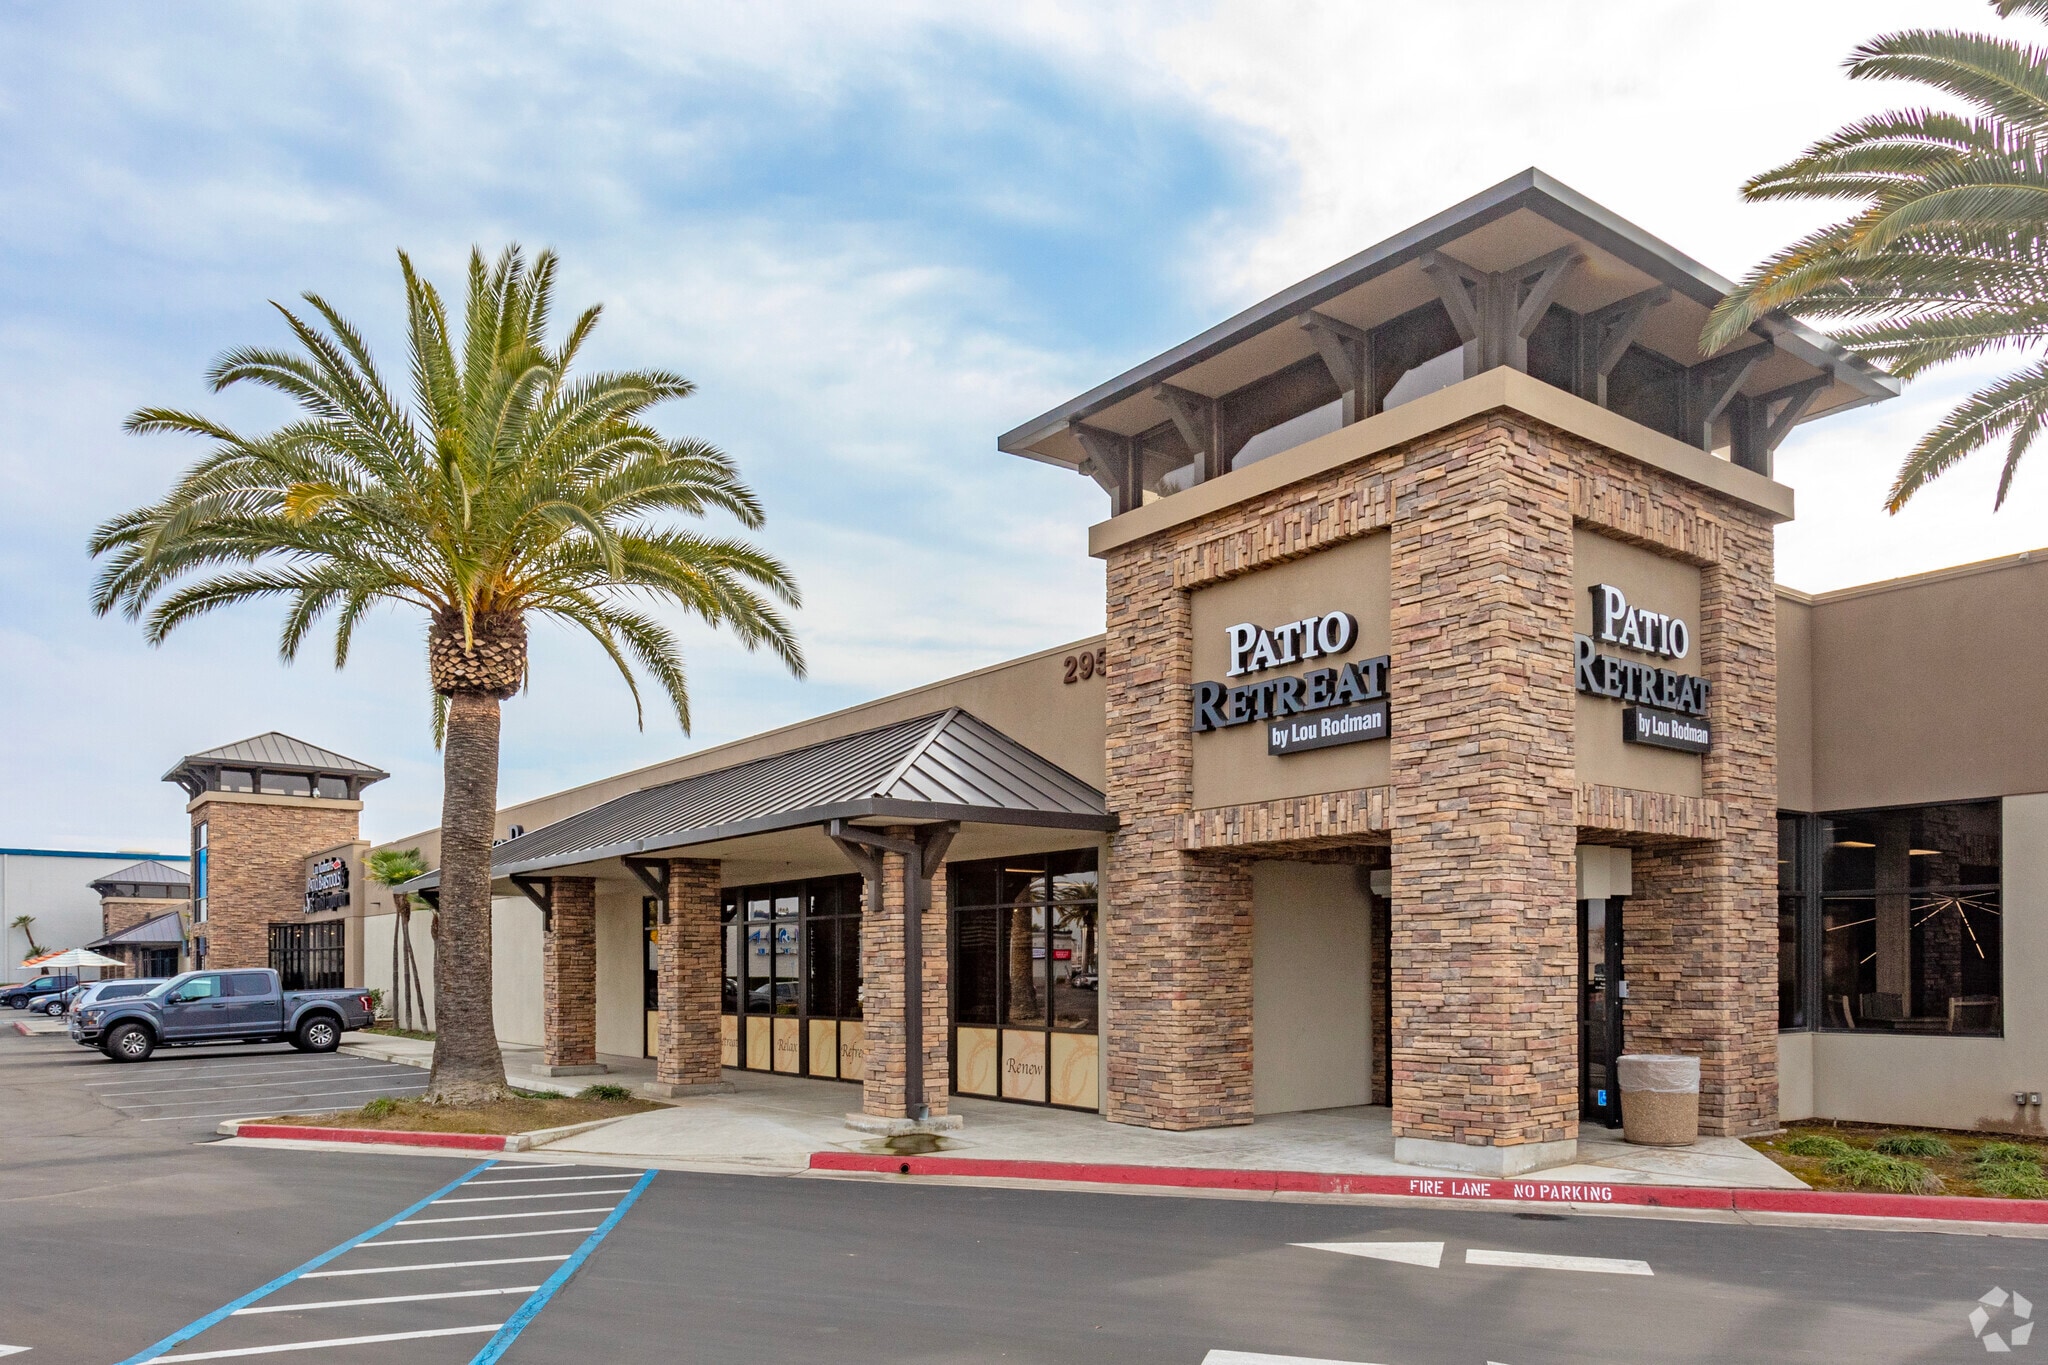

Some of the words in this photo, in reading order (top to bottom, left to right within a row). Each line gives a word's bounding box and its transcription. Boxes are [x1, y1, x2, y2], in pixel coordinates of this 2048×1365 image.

[1600, 583, 1690, 660] PATIO
[1225, 610, 1352, 678] PATIO
[1063, 648, 1106, 684] 295
[1573, 632, 1712, 716] RETREAT
[1191, 654, 1389, 733] RETREAT
[1272, 727, 1289, 749] by
[1292, 722, 1317, 743] Lou
[1321, 712, 1382, 737] Rodman
[1638, 712, 1651, 737] by
[1652, 715, 1670, 738] Lou
[1671, 719, 1709, 745] Rodman
[776, 1036, 799, 1053] Relax
[841, 1041, 864, 1065] Refre
[1006, 1057, 1044, 1075] Renew
[1409, 1179, 1444, 1196] FIRE
[1451, 1181, 1491, 1197] LANE
[1514, 1183, 1536, 1199] NO
[1539, 1184, 1613, 1201] PARKING
